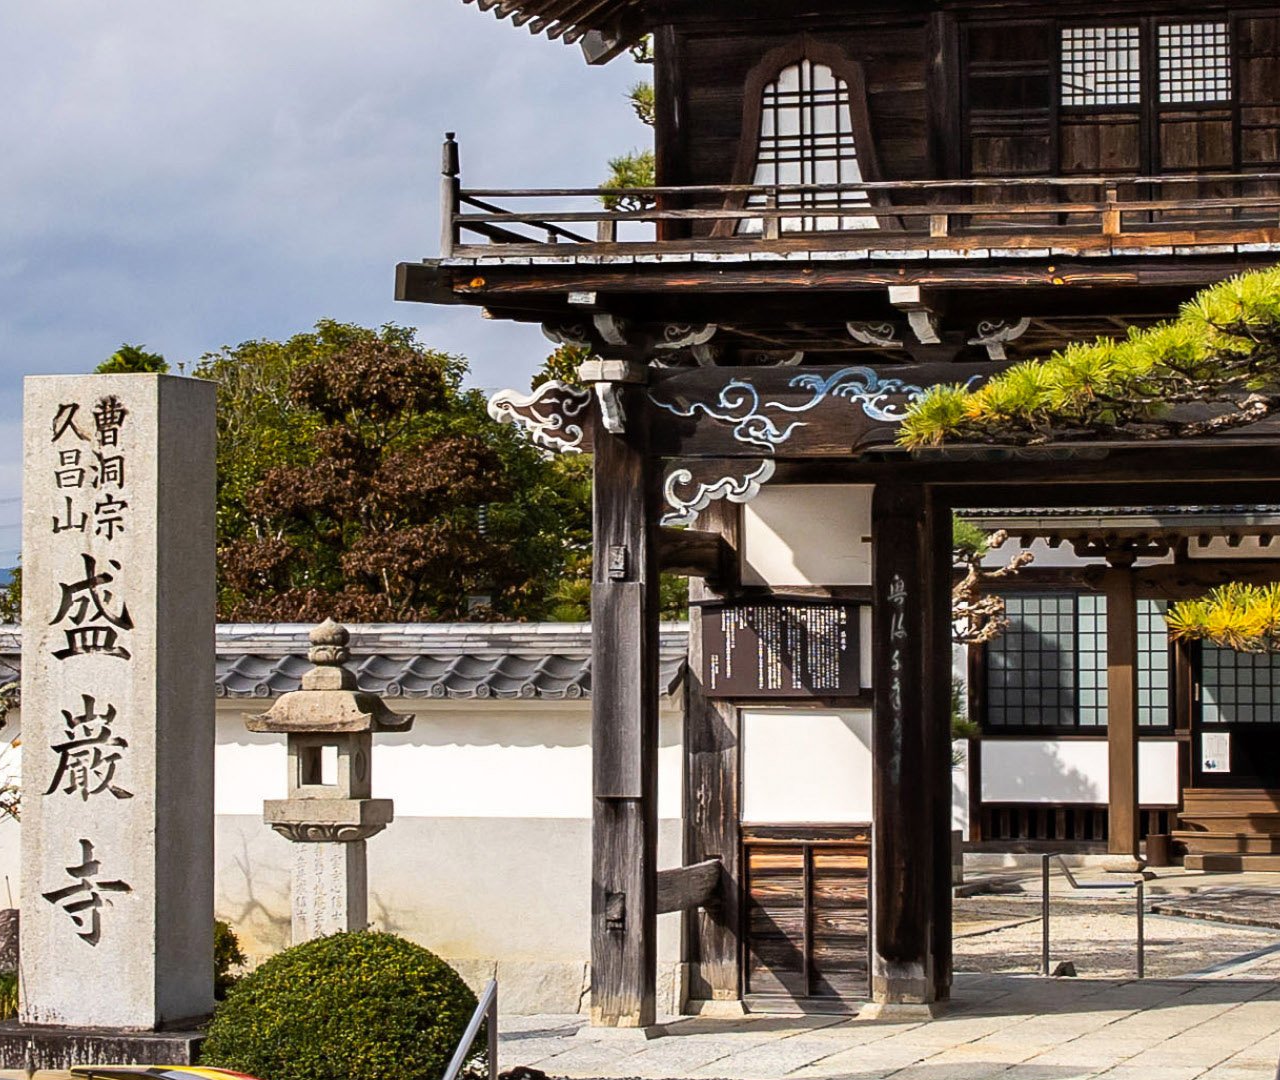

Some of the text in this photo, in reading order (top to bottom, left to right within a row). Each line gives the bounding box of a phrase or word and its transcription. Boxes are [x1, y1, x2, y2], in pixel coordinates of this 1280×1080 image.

[51, 402, 91, 534] 久昌山
[89, 395, 129, 541] 曹洞宗
